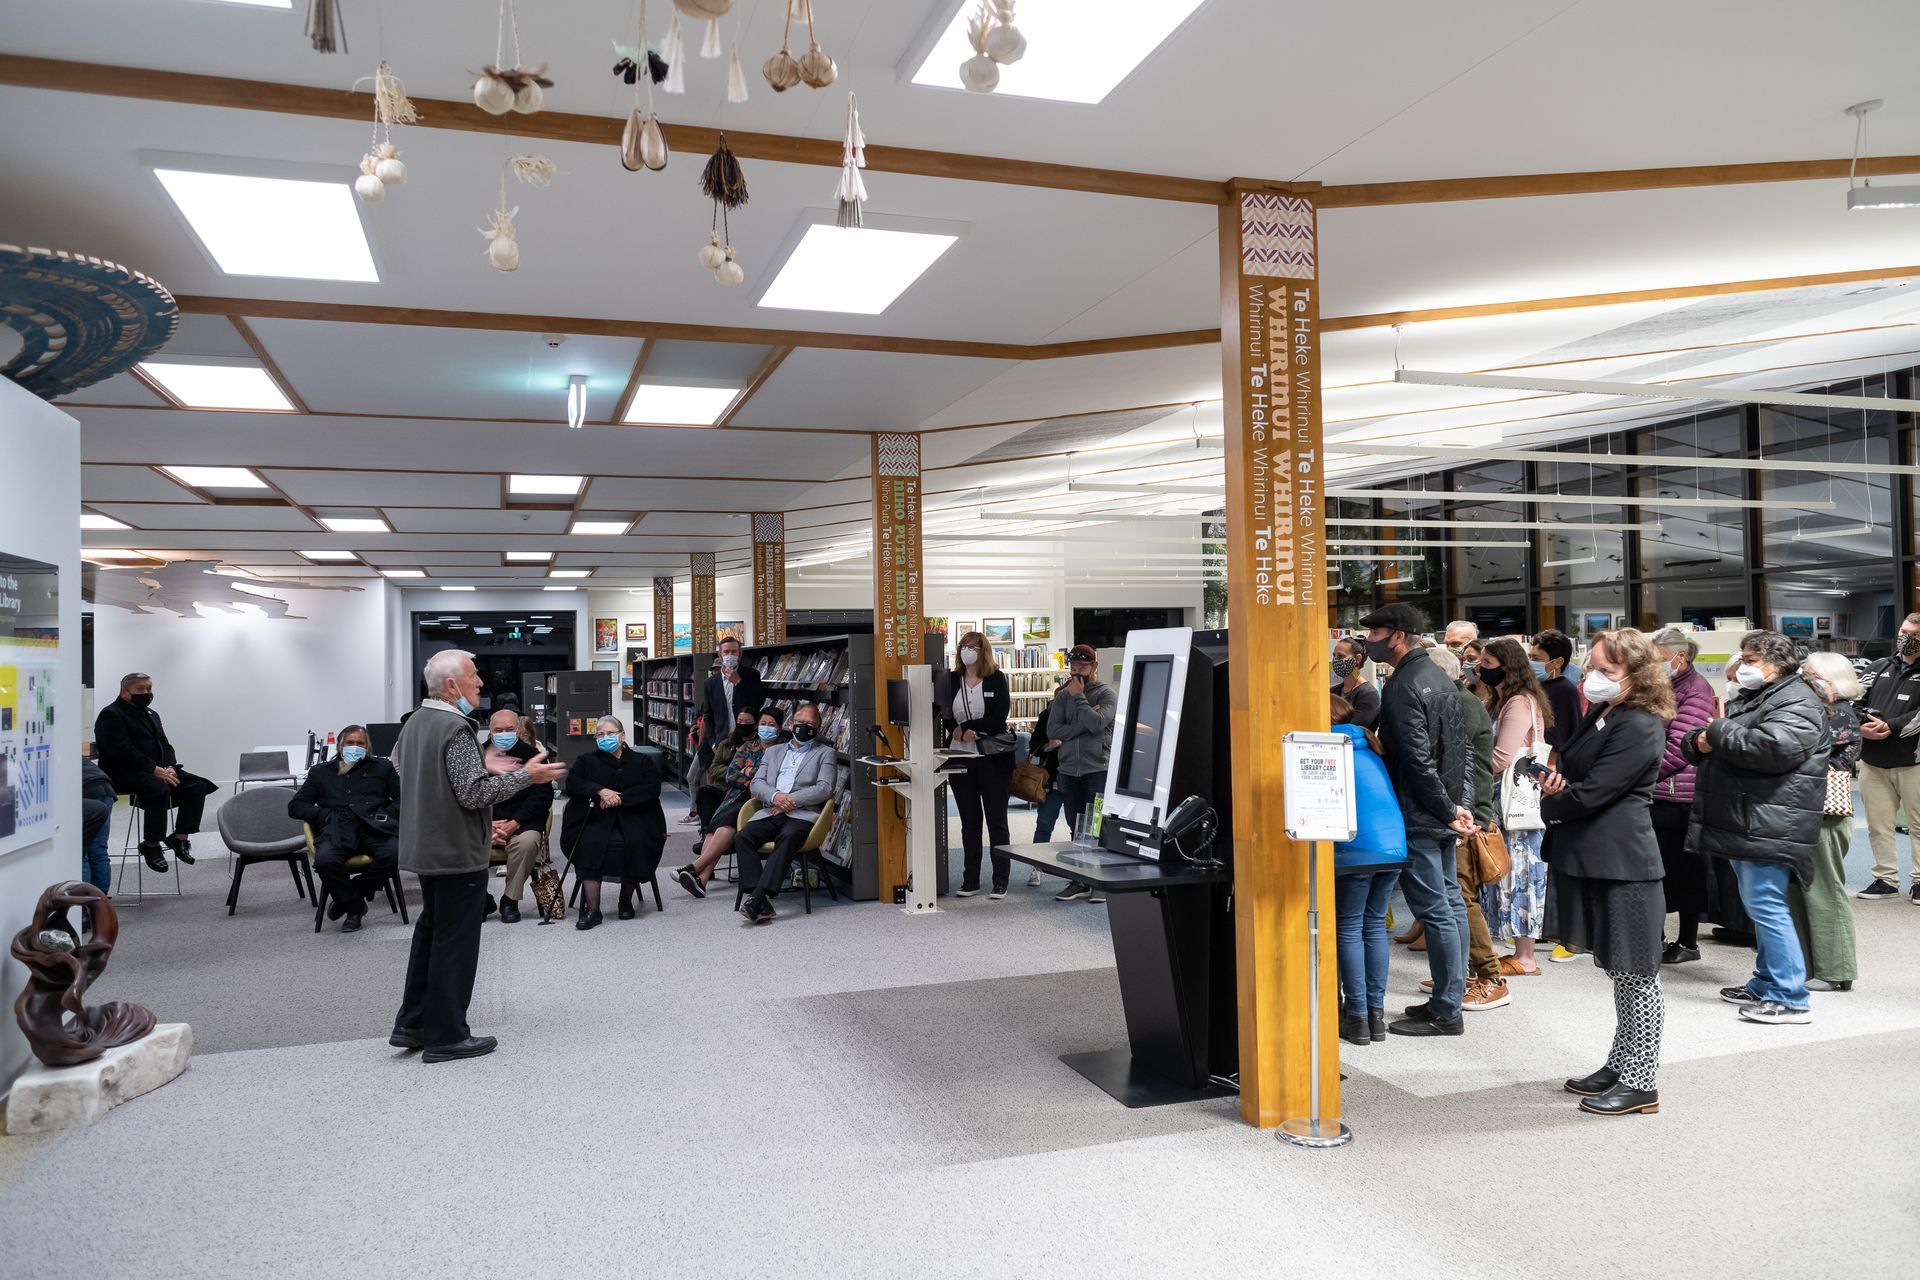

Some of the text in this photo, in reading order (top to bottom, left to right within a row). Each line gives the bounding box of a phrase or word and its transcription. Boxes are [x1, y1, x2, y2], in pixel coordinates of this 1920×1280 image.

[1249, 285, 1274, 605] Whirinui Te Heke Whirinui Te Heke
[1294, 288, 1317, 606] Te Heke Whirinui Te Heke Whirinui
[907, 480, 917, 494] Te
[907, 496, 917, 520] Heke
[908, 524, 916, 545] Niho
[882, 480, 894, 658] Niho Puta Te Heke Niho Puta Te Heke
[909, 571, 918, 583] Te
[8, 574, 18, 590] the
[909, 586, 918, 611] Heke
[910, 614, 918, 635] Niho
[910, 638, 918, 658] Puta
